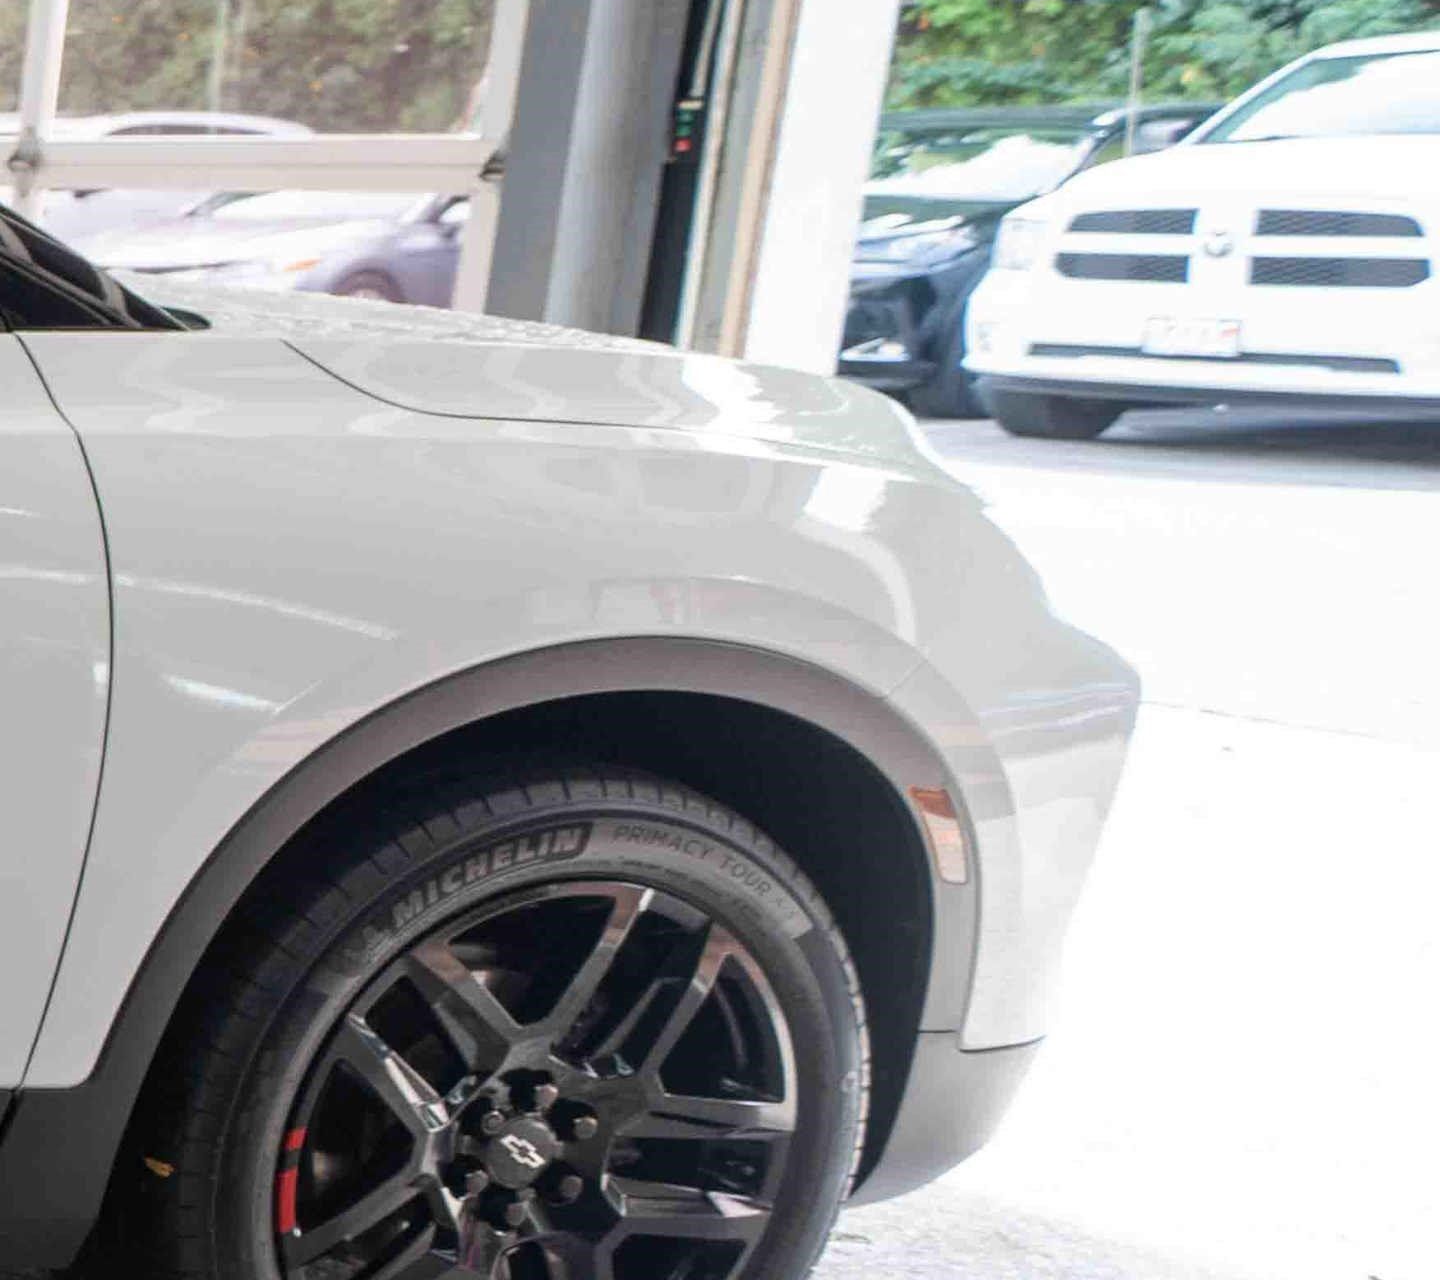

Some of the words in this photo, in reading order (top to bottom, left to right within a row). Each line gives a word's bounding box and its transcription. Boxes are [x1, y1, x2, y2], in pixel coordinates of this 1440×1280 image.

[392, 826, 587, 927] MICHELIN
[612, 823, 715, 861] PRIMACY
[718, 853, 772, 897] TOUR
